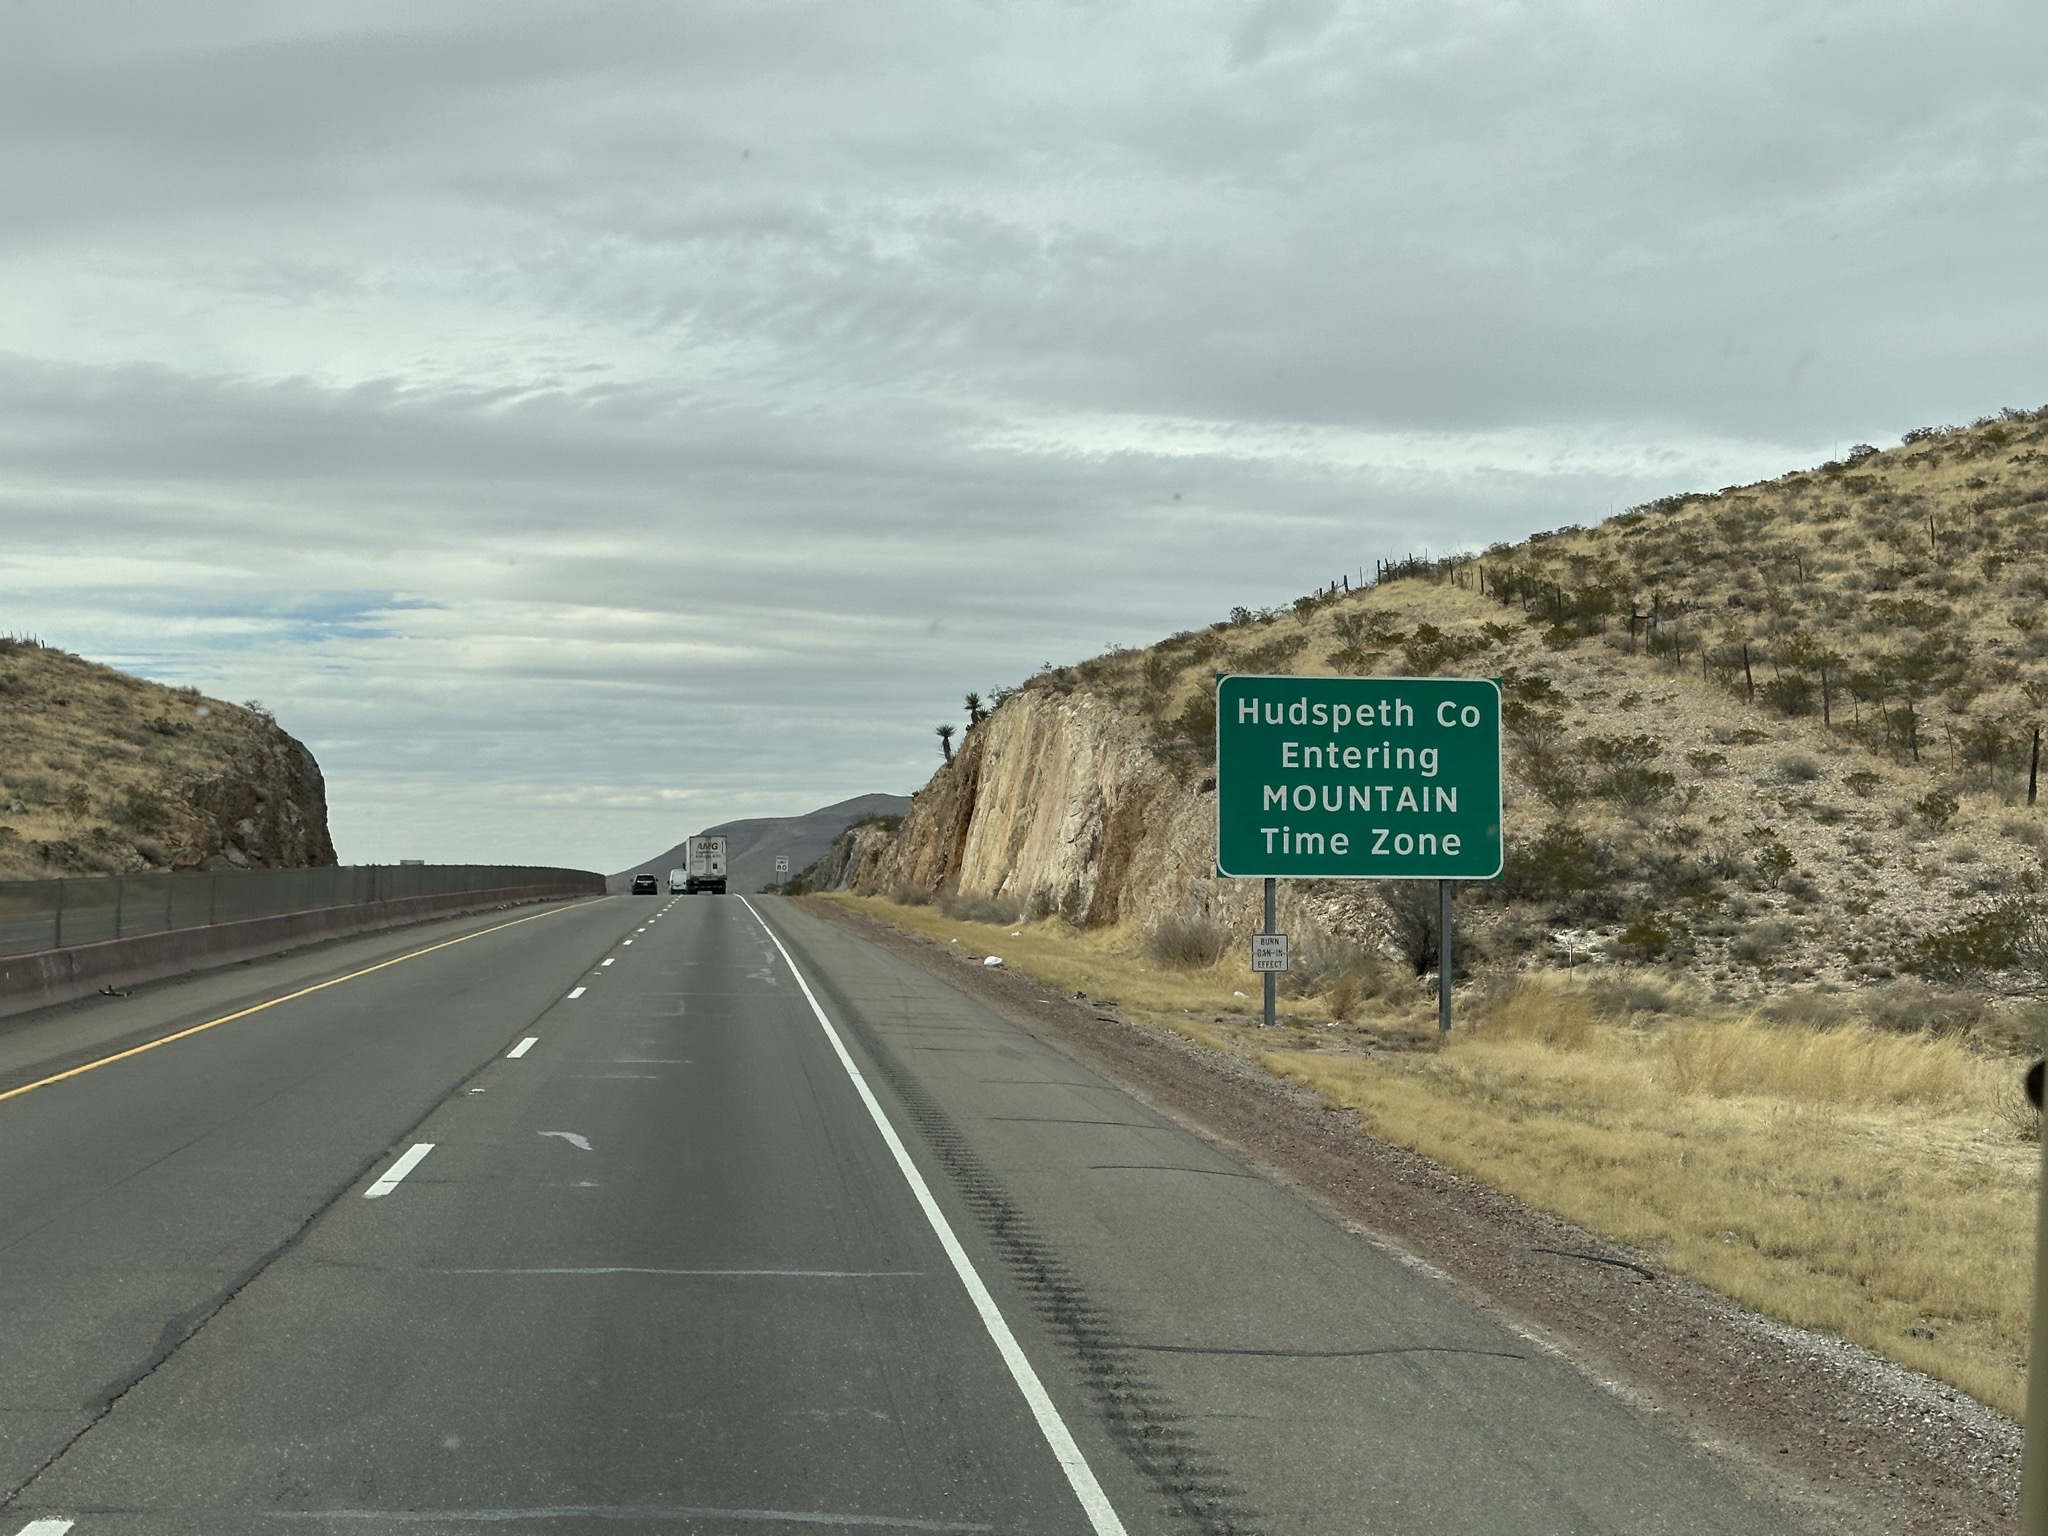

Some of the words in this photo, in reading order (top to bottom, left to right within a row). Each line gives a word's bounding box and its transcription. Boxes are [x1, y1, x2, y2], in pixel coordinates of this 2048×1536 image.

[1237, 696, 1415, 733] Hudspeth
[1436, 701, 1481, 728] Co
[1282, 741, 1439, 777] Entering
[1262, 784, 1458, 813] MOUNTAIN
[697, 842, 718, 850] AMG
[1260, 826, 1350, 855] Time
[1371, 828, 1461, 856] Zone
[1257, 960, 1283, 968] EFFECT
[1275, 949, 1283, 957] IN
